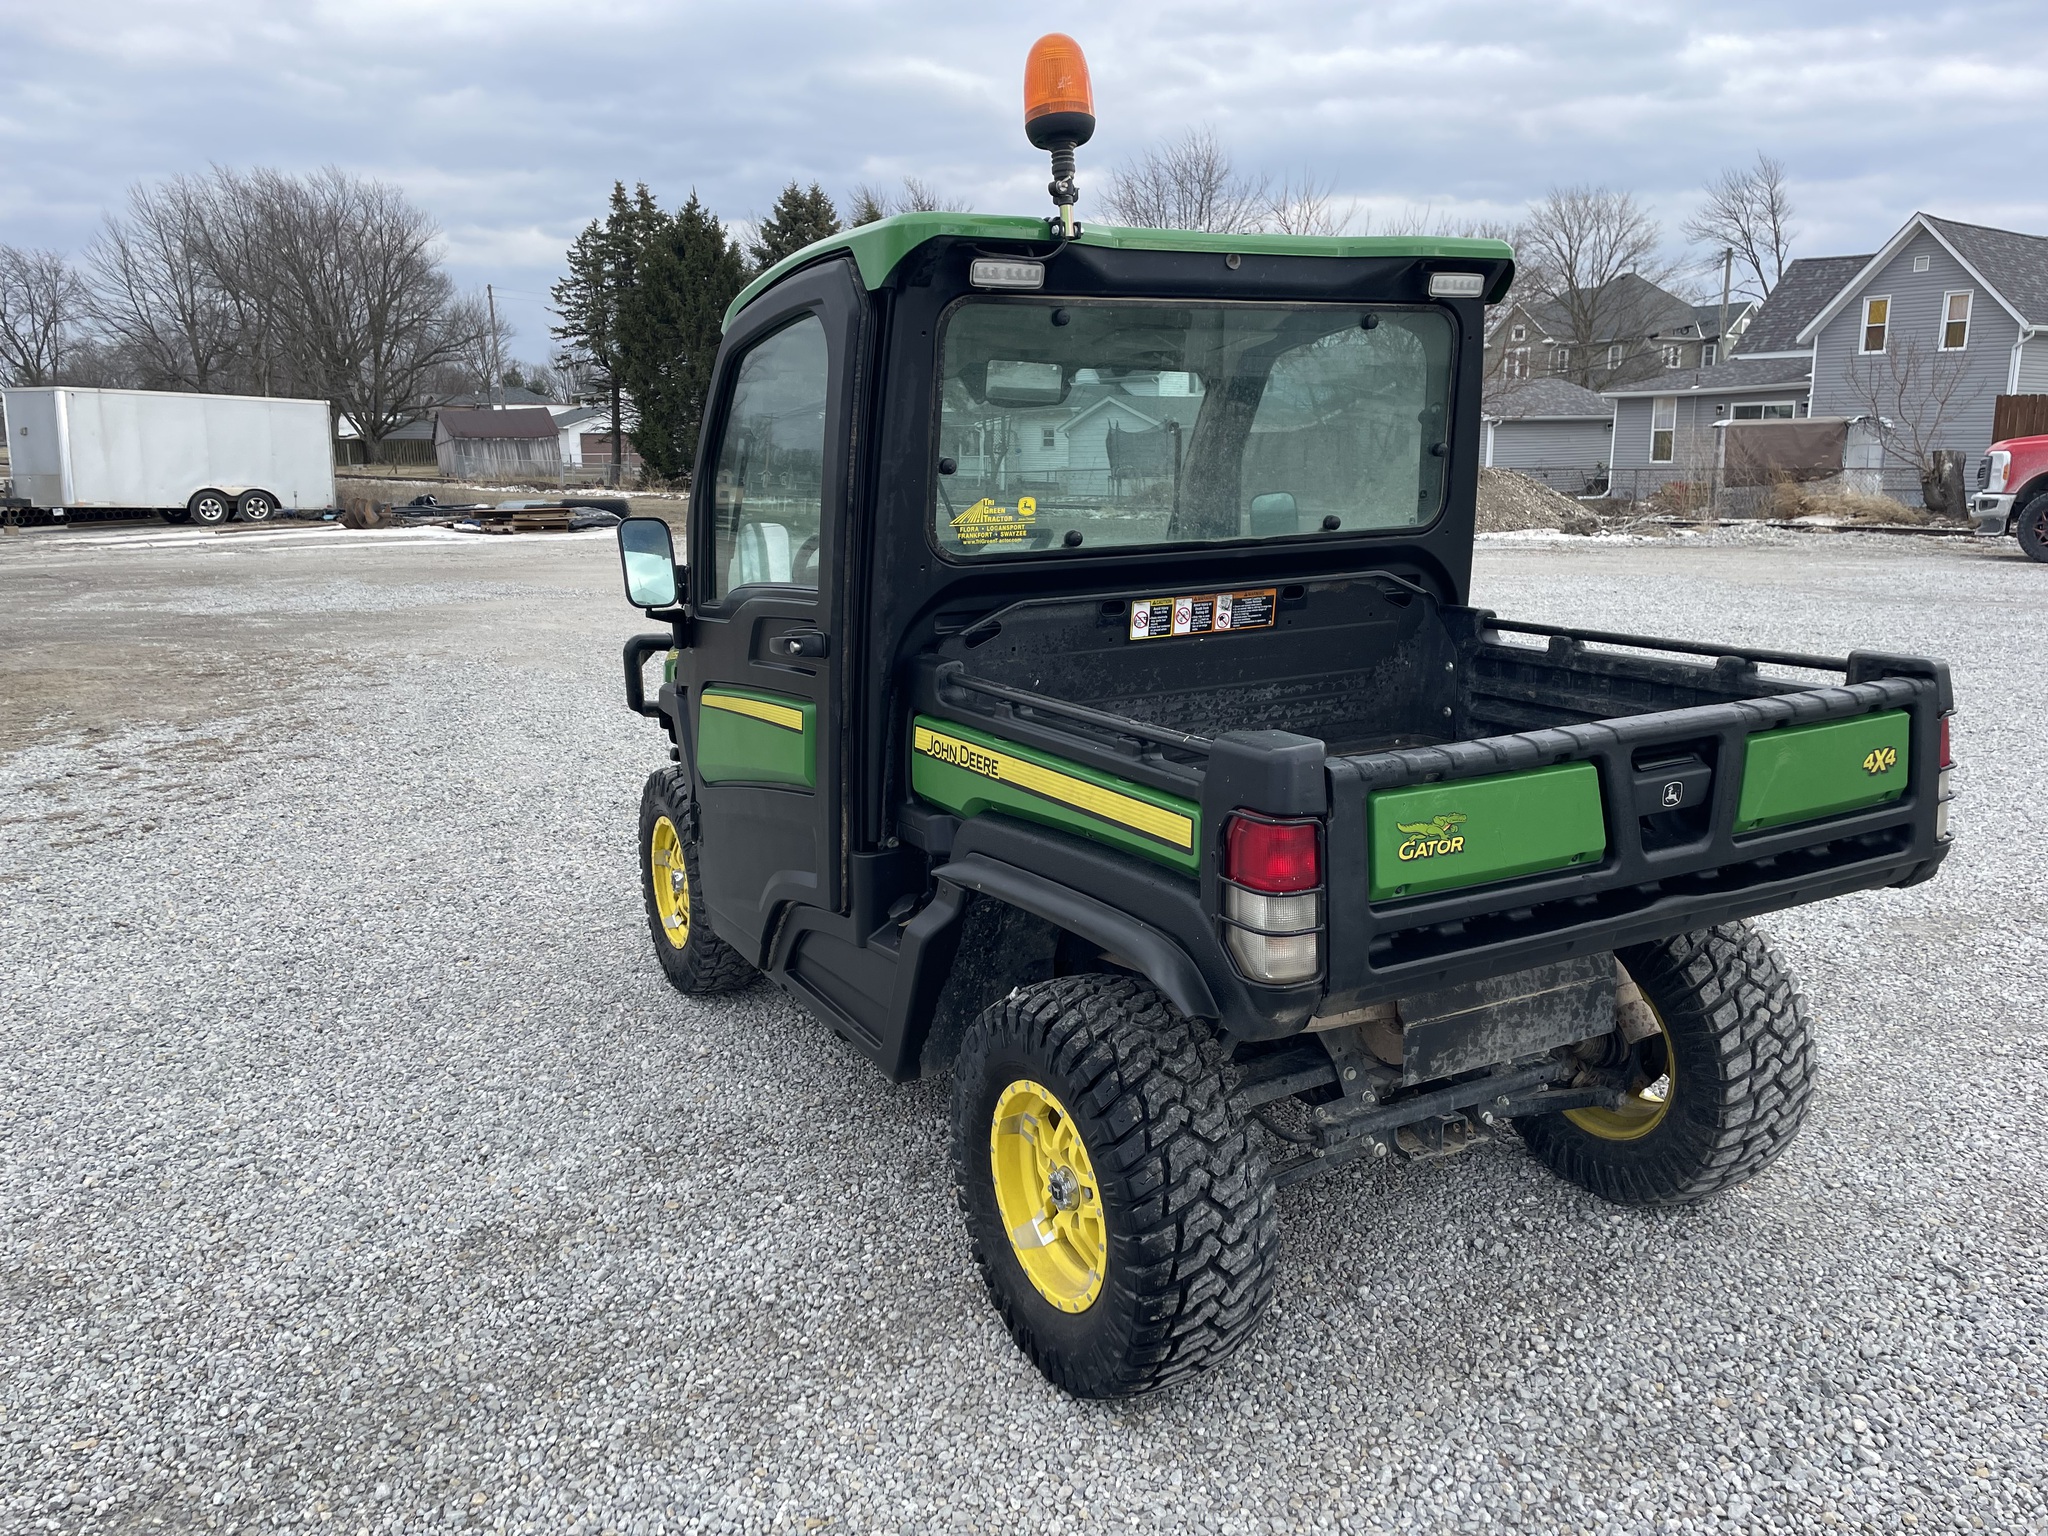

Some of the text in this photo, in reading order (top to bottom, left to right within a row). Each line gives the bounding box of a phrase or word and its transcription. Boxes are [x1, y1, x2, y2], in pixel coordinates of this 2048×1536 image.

[983, 506, 1006, 514] GREEN
[983, 515, 1013, 523] TRACTOR
[926, 735, 999, 776] JOHN DEERE
[1862, 746, 1897, 775] 4X4
[1398, 836, 1465, 861] GATOR
